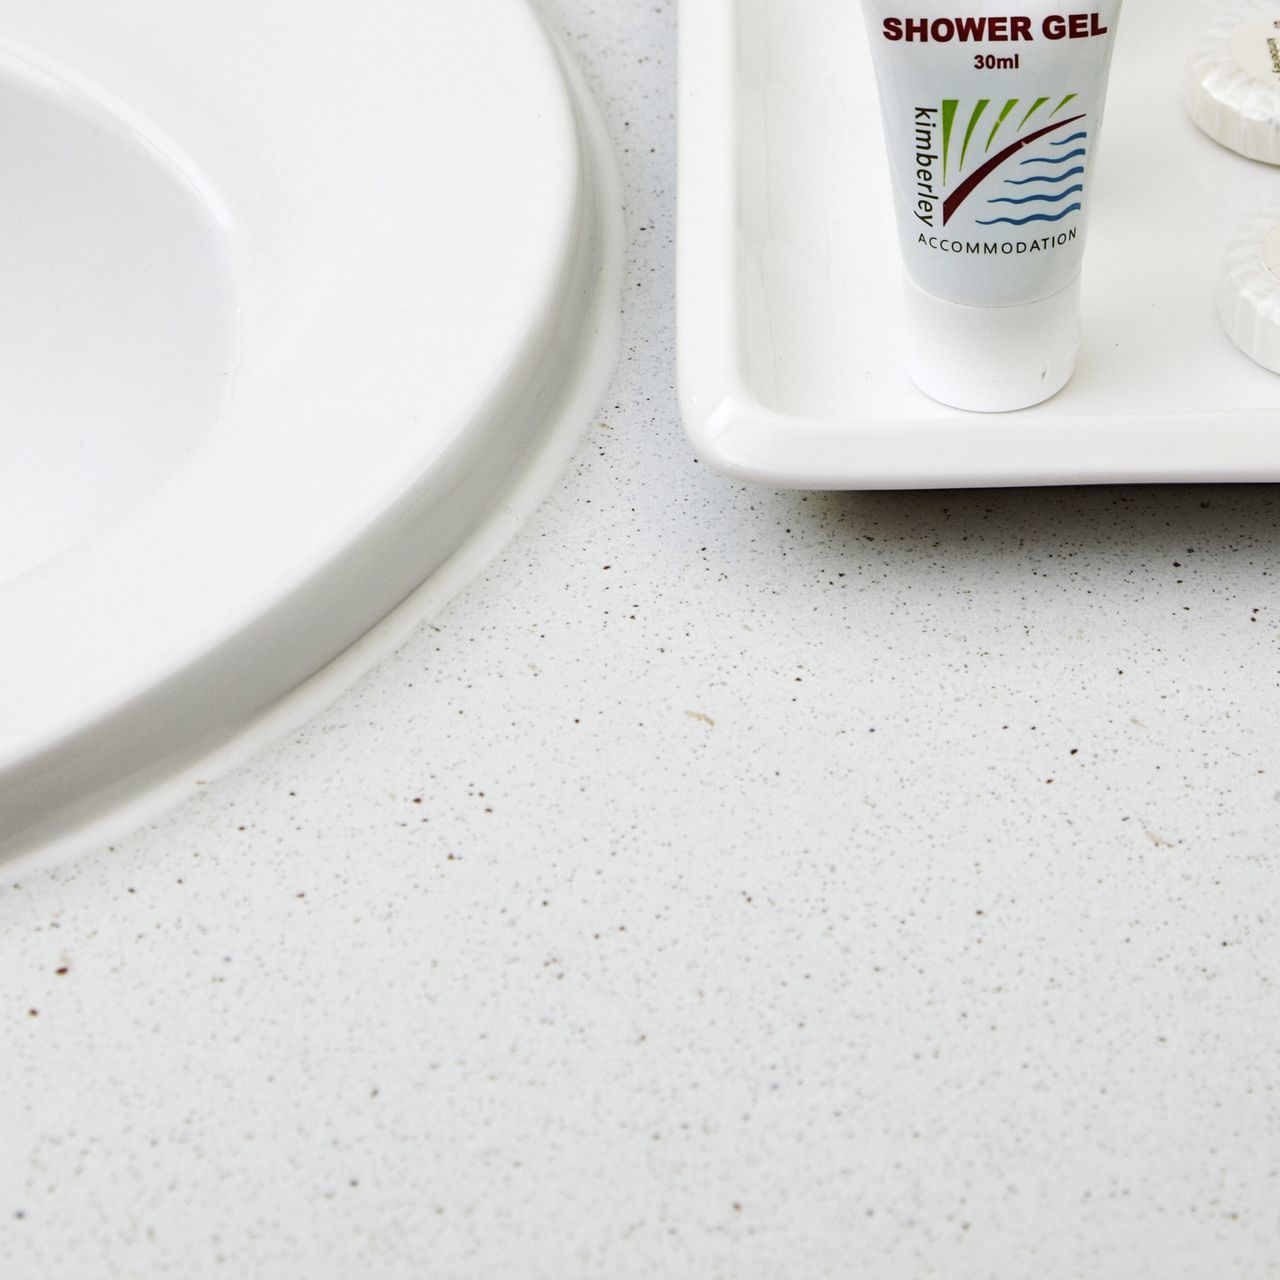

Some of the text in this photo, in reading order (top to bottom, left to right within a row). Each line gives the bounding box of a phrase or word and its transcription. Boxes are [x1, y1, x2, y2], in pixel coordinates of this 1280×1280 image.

[882, 12, 1108, 43] SHOWER GEL
[973, 53, 1020, 70] 30ml
[913, 106, 940, 228] kimberley
[918, 226, 1077, 255] ACCOMMODATION
